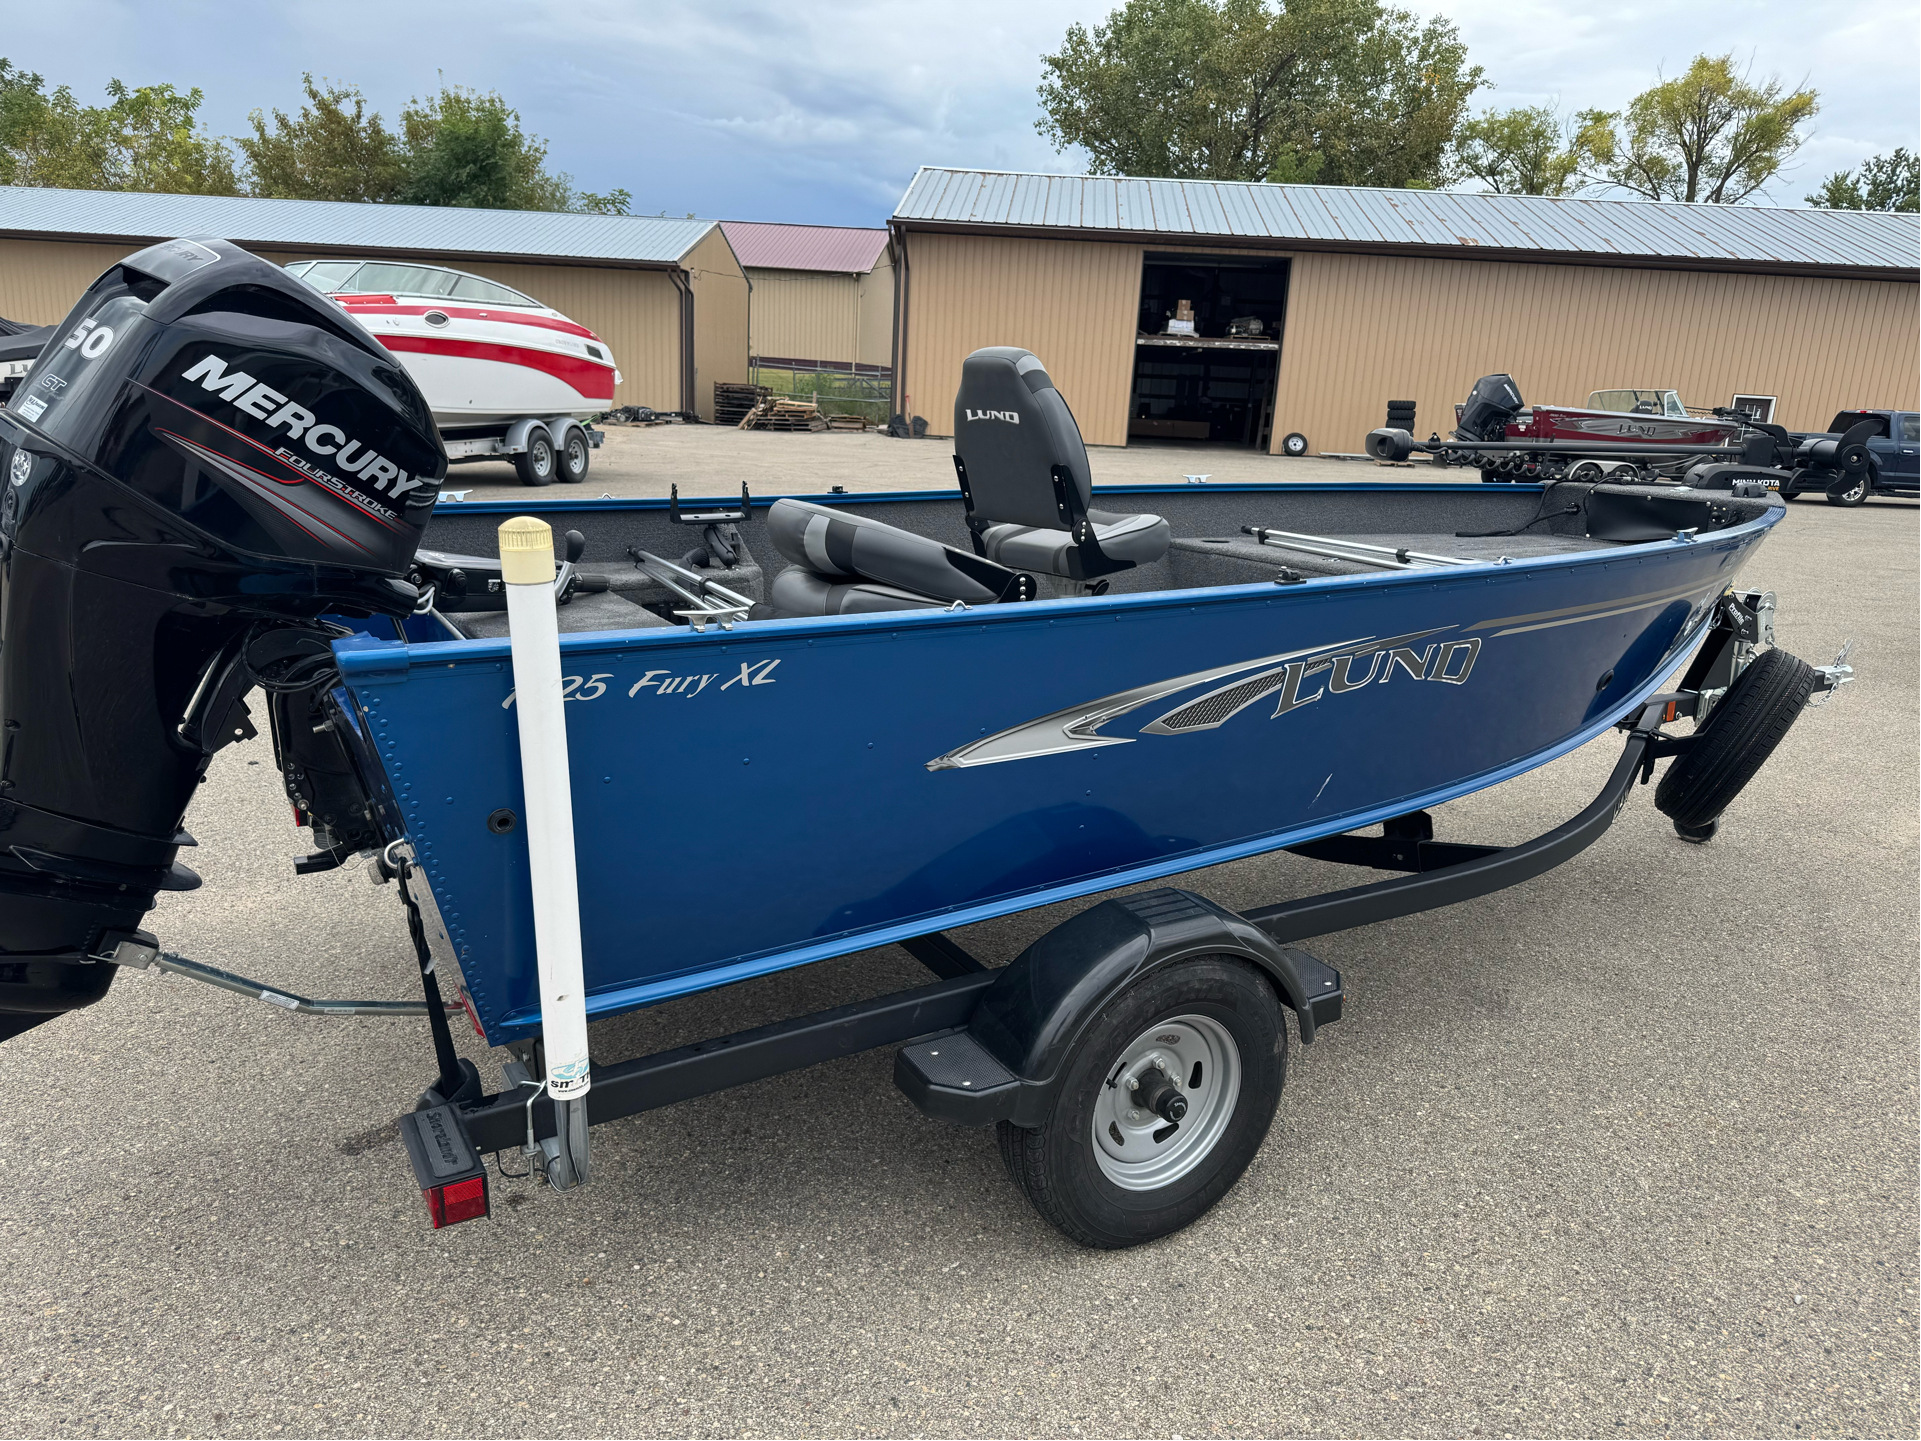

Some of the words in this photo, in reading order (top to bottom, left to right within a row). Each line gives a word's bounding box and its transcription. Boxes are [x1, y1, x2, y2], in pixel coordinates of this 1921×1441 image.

[64, 317, 114, 359] 50
[182, 355, 423, 499] MERCURY
[965, 409, 1019, 425] LUND
[1617, 424, 1656, 437] LUND
[274, 447, 398, 520] FOURSTROKE
[628, 670, 720, 698] Fury
[720, 659, 781, 691] XL
[1270, 638, 1482, 720] LUND
